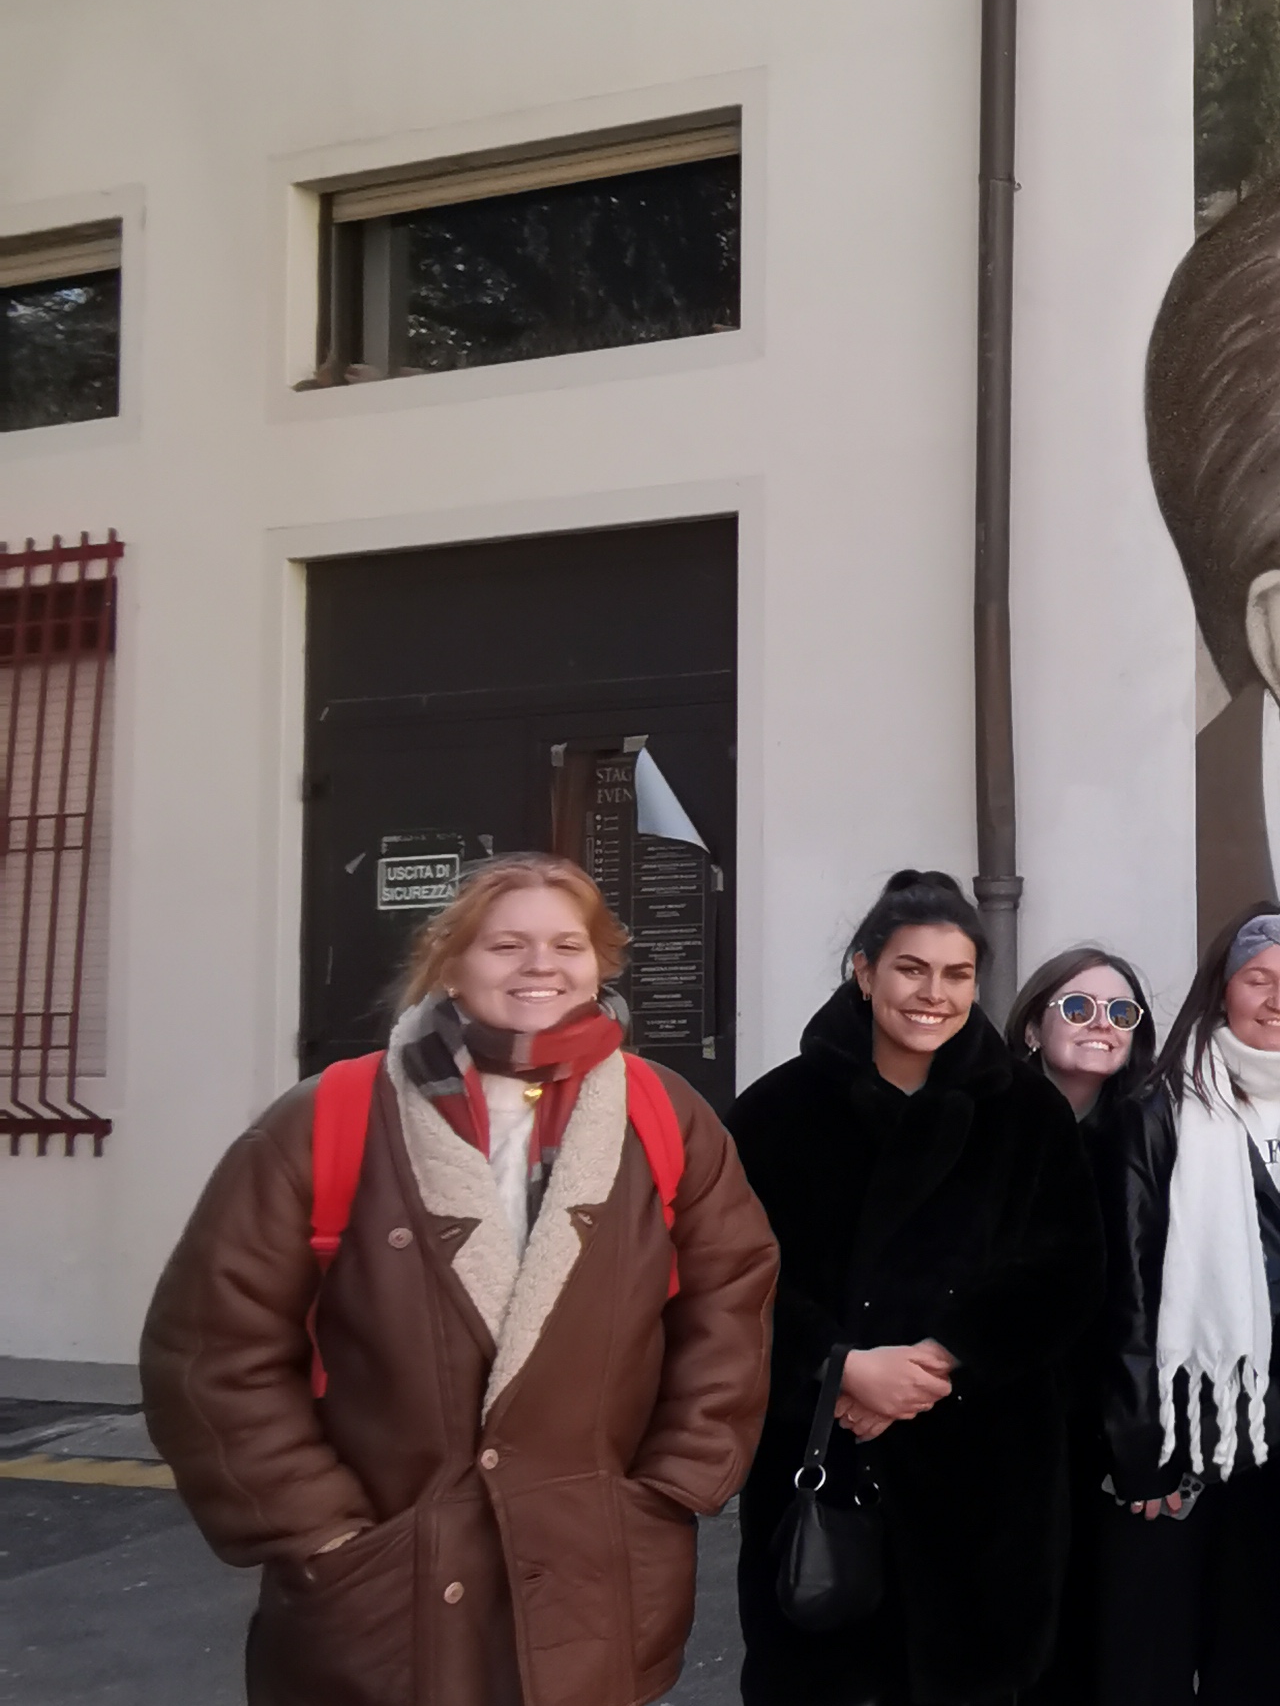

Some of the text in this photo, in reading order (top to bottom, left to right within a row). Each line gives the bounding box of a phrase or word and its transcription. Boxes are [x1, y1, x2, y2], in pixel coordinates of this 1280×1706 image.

[387, 864, 450, 881] USCITA DI
[382, 884, 456, 902] SICUREZZA
